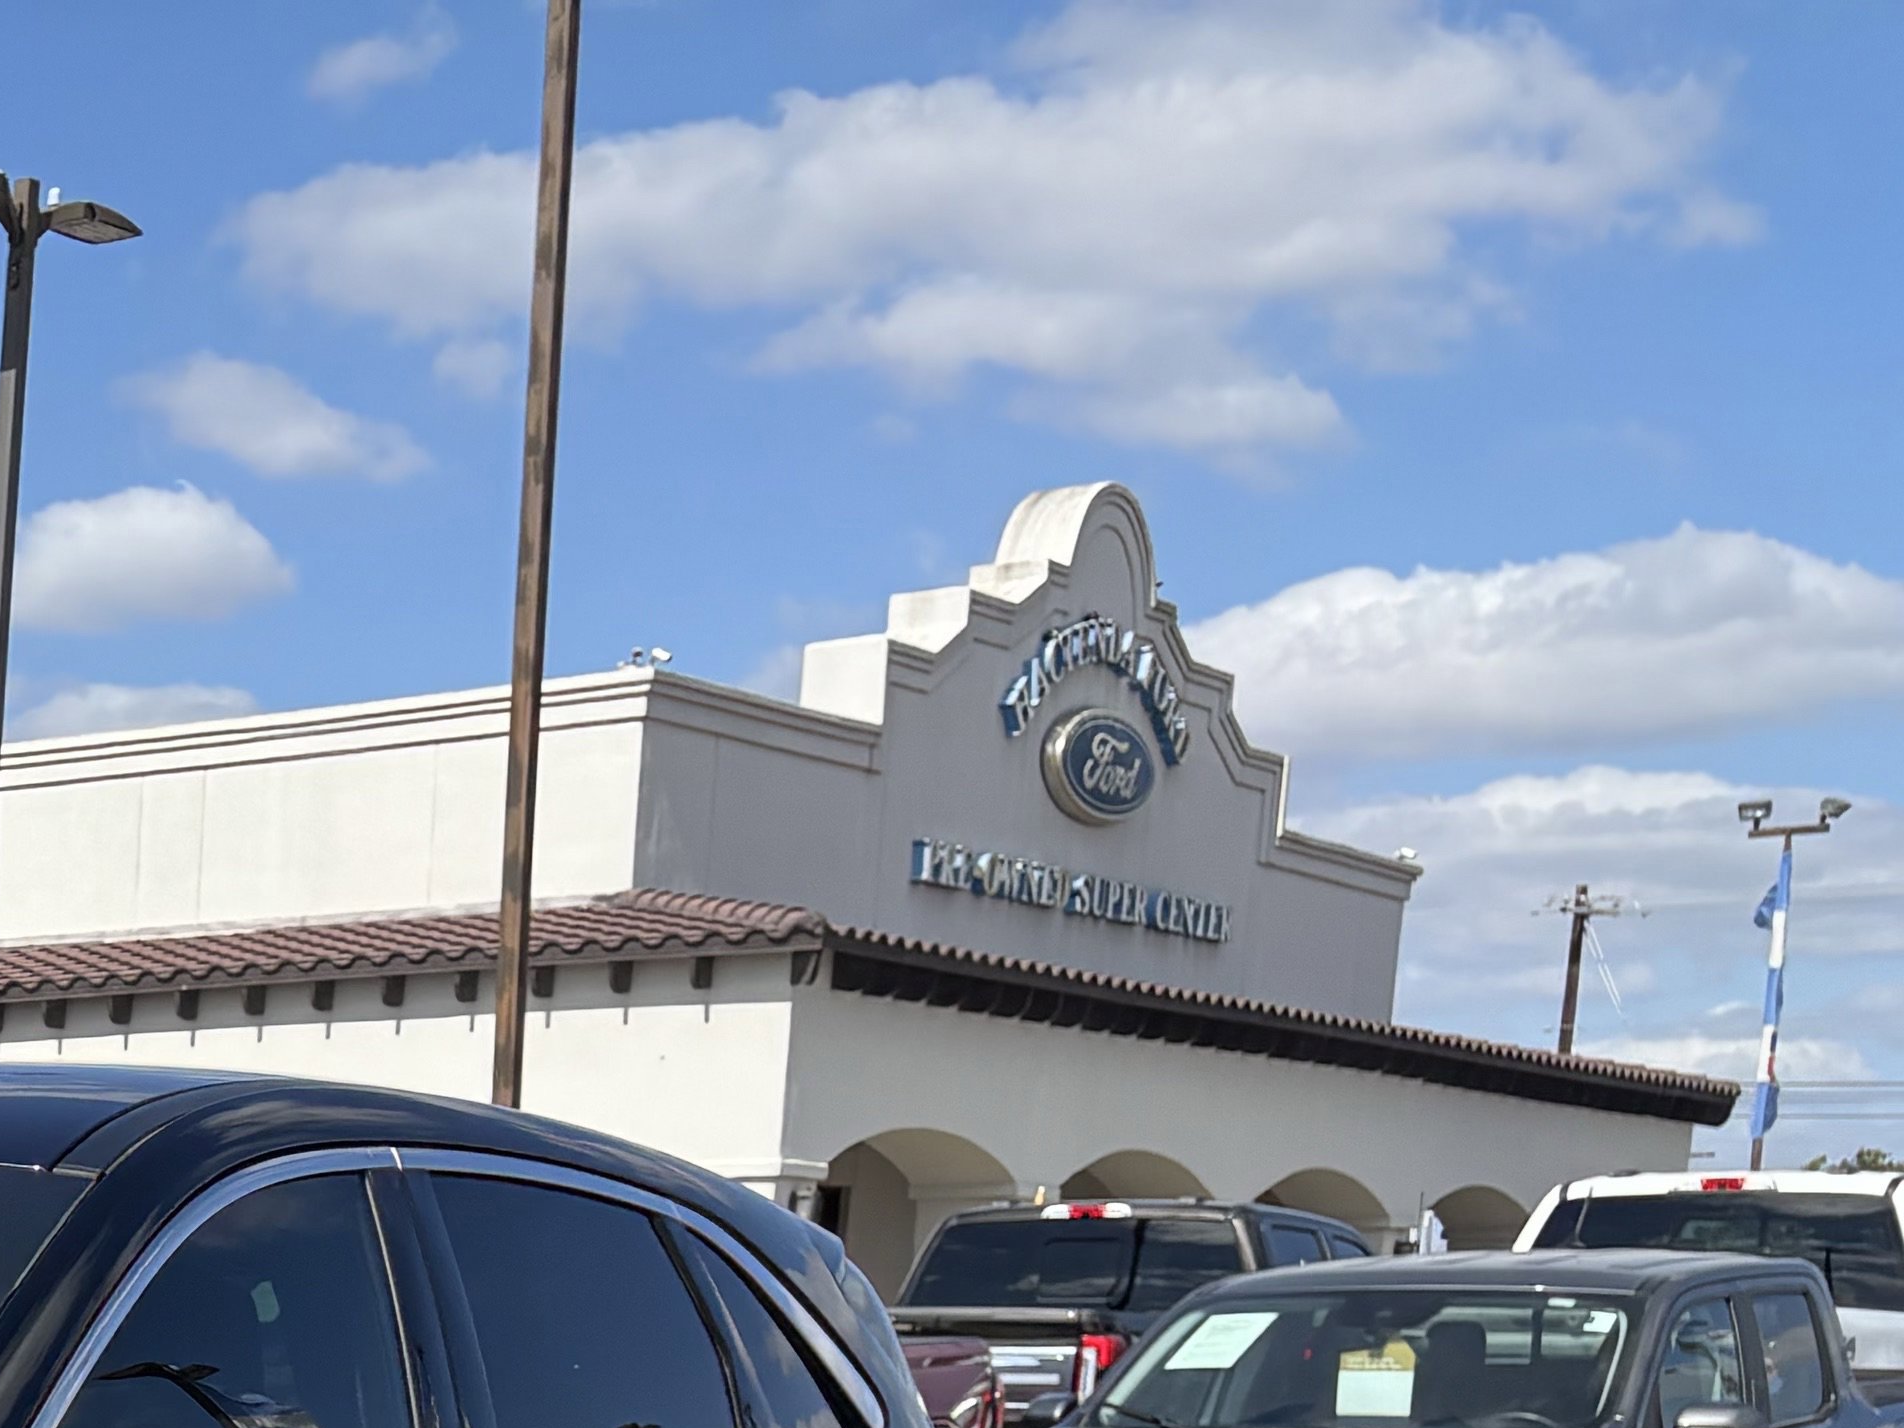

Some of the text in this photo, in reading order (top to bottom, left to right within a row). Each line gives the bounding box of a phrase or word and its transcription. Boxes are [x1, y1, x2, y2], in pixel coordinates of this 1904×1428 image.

[1000, 612, 1136, 736] HACIENDA
[1083, 733, 1140, 799] Ford
[1068, 874, 1147, 925] SUPER
[1150, 891, 1231, 942] CENTER
